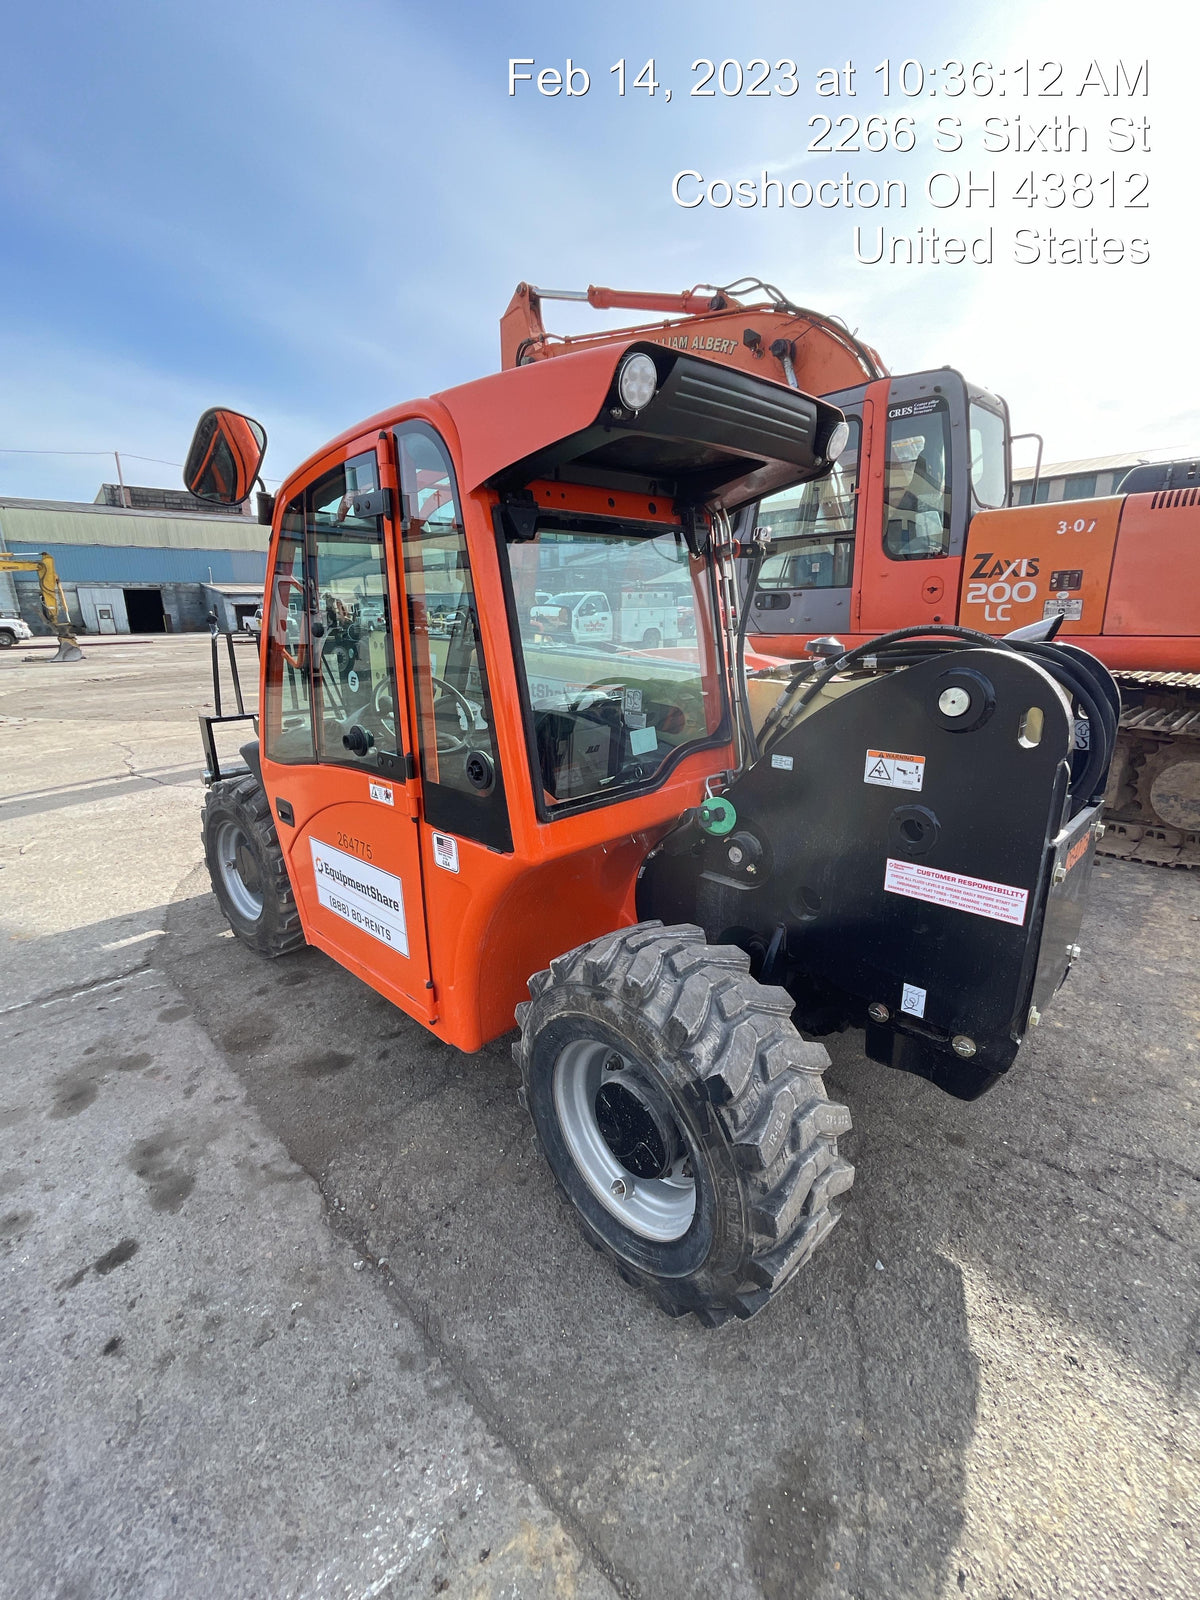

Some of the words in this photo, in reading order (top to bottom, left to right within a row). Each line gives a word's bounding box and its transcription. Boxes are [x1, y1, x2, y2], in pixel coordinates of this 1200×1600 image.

[691, 336, 738, 355] ALBERT
[888, 406, 913, 419] CRES
[966, 581, 1037, 604] 200
[984, 604, 1012, 622] LC
[337, 831, 373, 860] 264775
[323, 862, 400, 912] EquipmentShare
[916, 868, 957, 883] CUSTOMER
[958, 878, 1025, 899] RESPONSIBILITY
[329, 895, 350, 917] (888)
[351, 909, 391, 941] 80-RENTS
